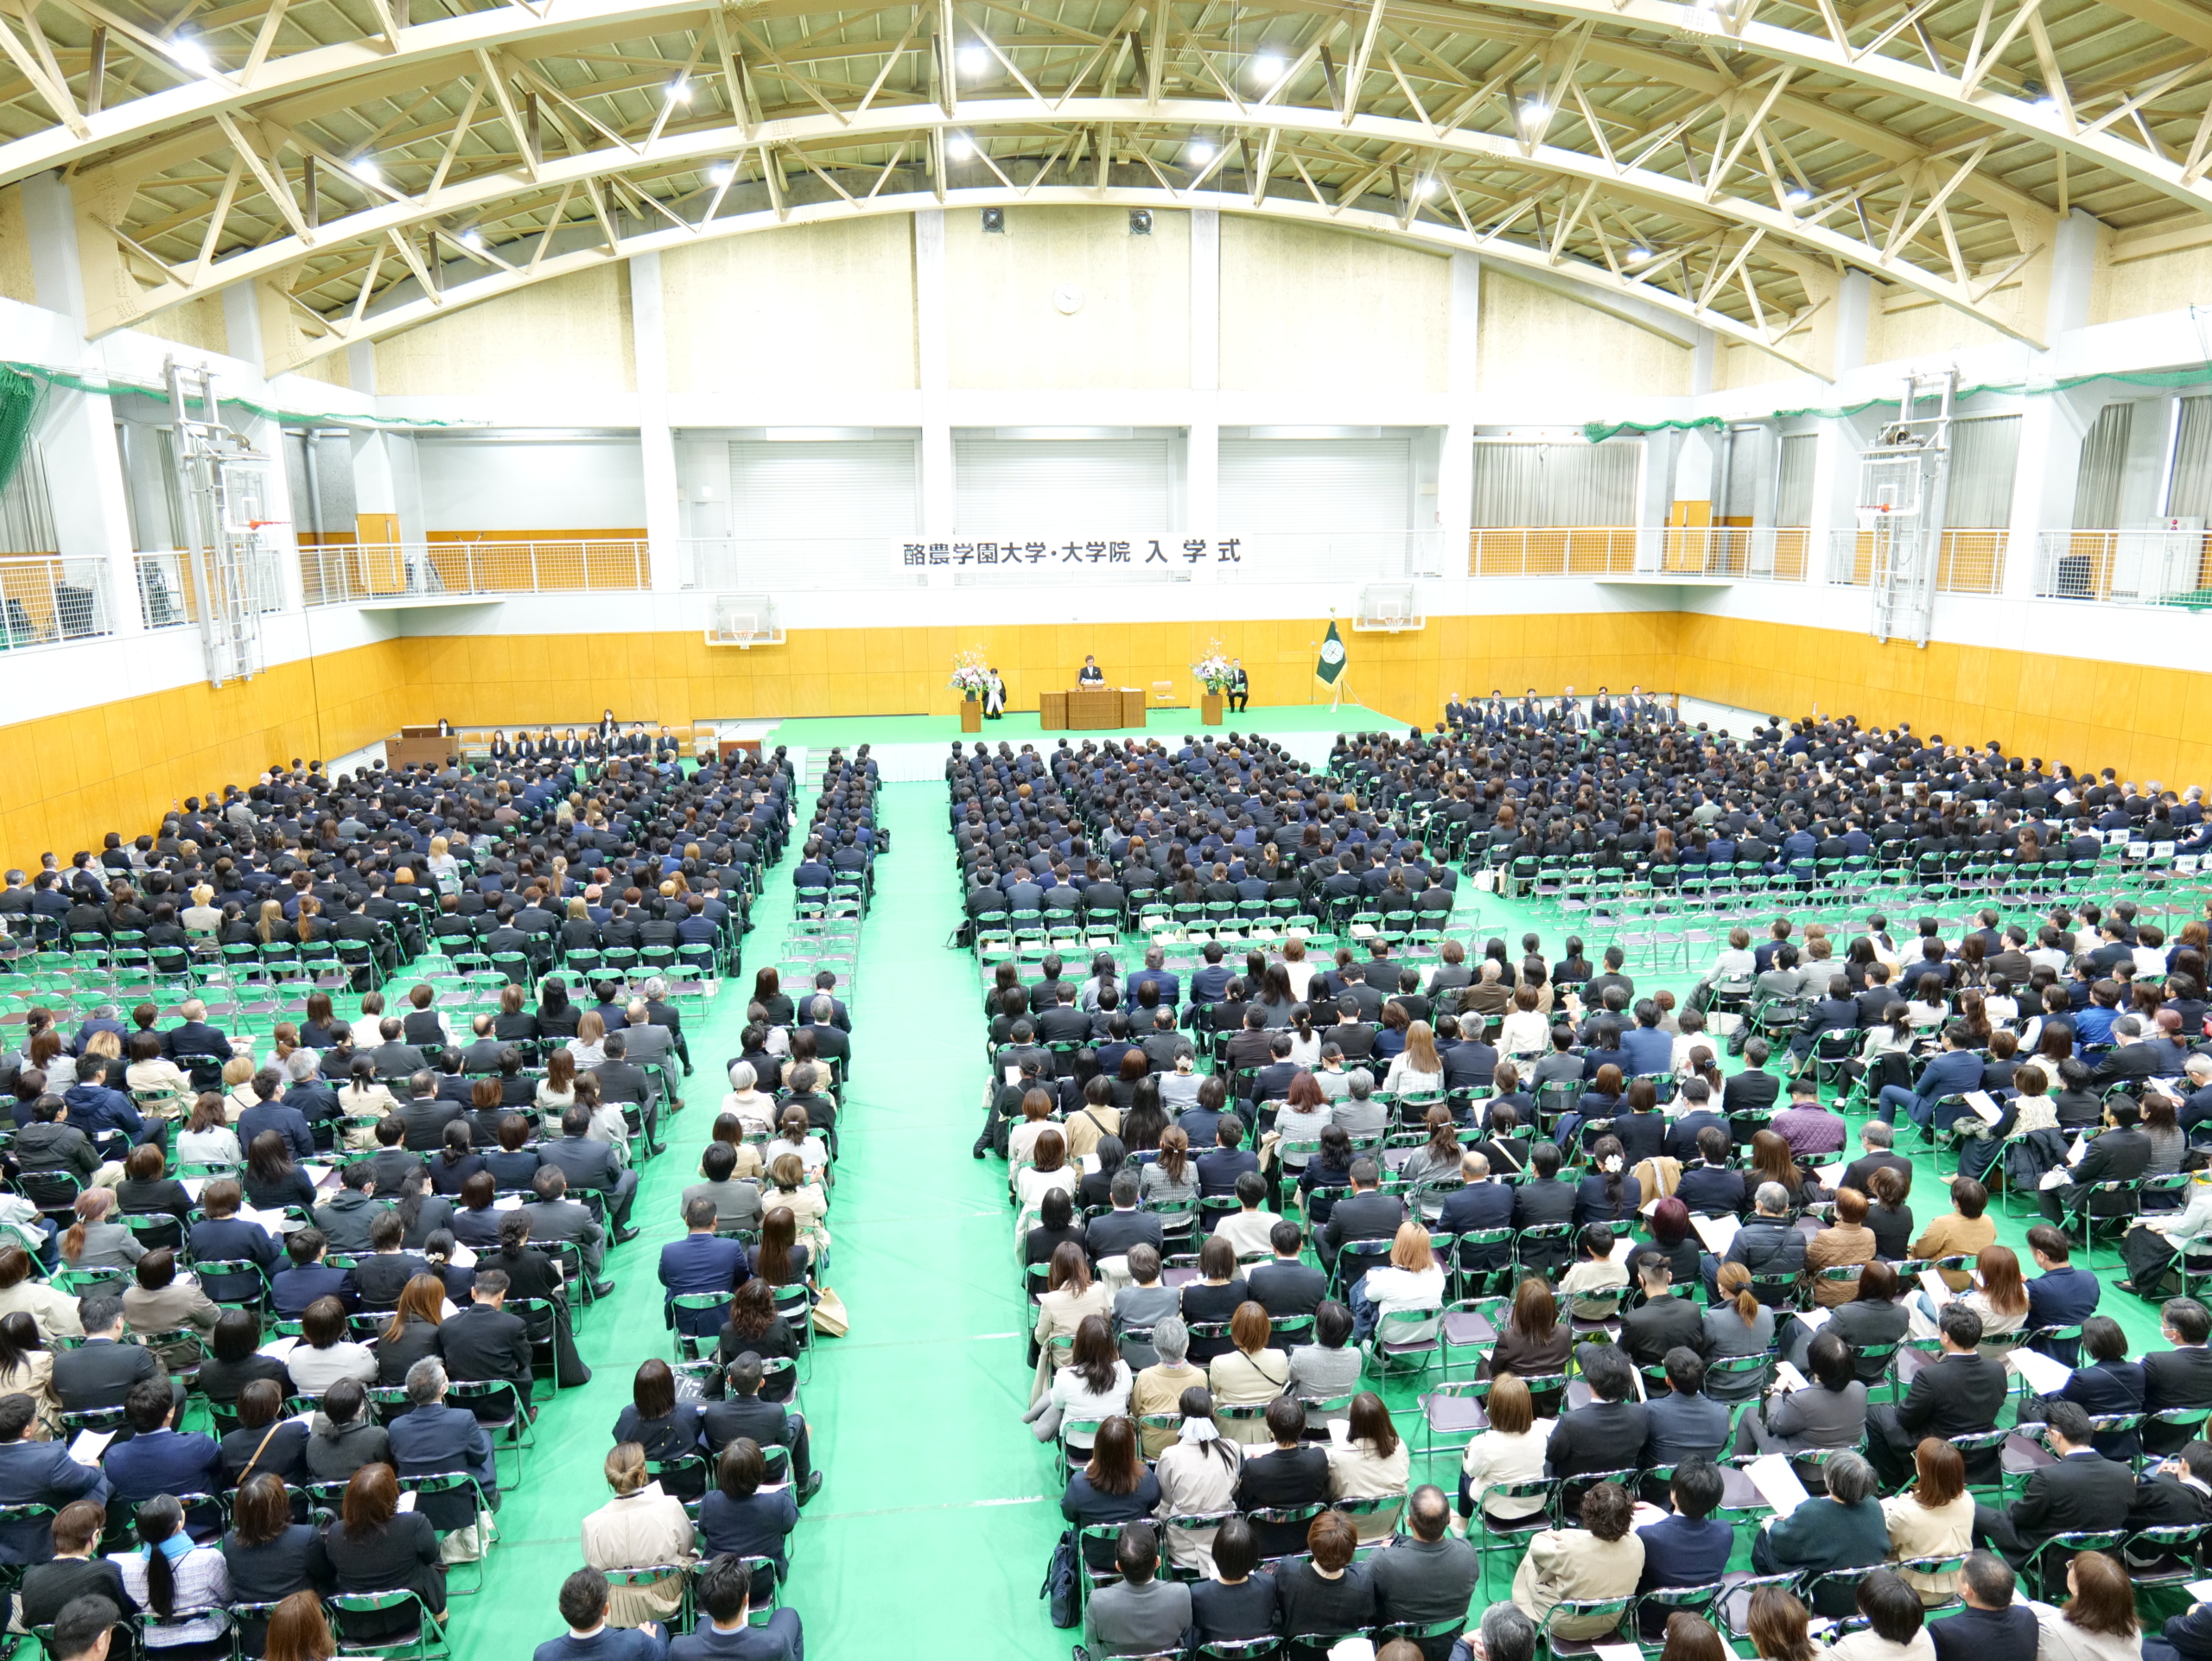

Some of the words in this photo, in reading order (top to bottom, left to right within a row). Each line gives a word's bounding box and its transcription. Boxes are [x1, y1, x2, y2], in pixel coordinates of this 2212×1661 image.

[903, 541, 1131, 565] 酪農学園大学・大学院
